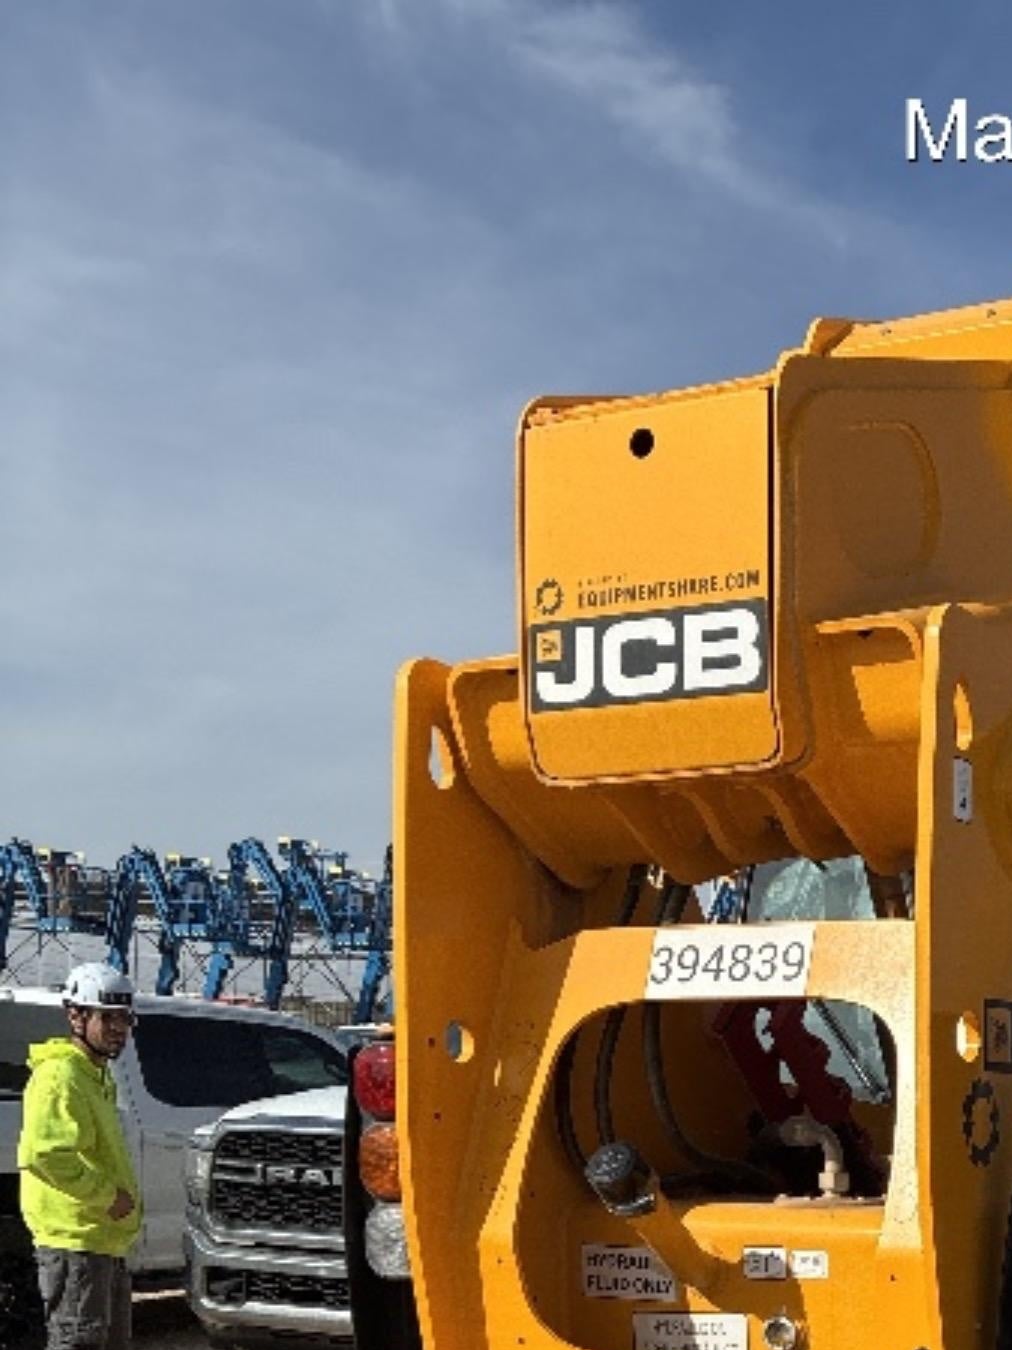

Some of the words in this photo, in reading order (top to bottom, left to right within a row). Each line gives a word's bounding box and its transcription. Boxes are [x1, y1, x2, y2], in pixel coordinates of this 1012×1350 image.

[578, 570, 760, 609] EQUIPMENTSHARE.COM
[536, 608, 762, 703] JCB
[650, 941, 805, 984] 394839
